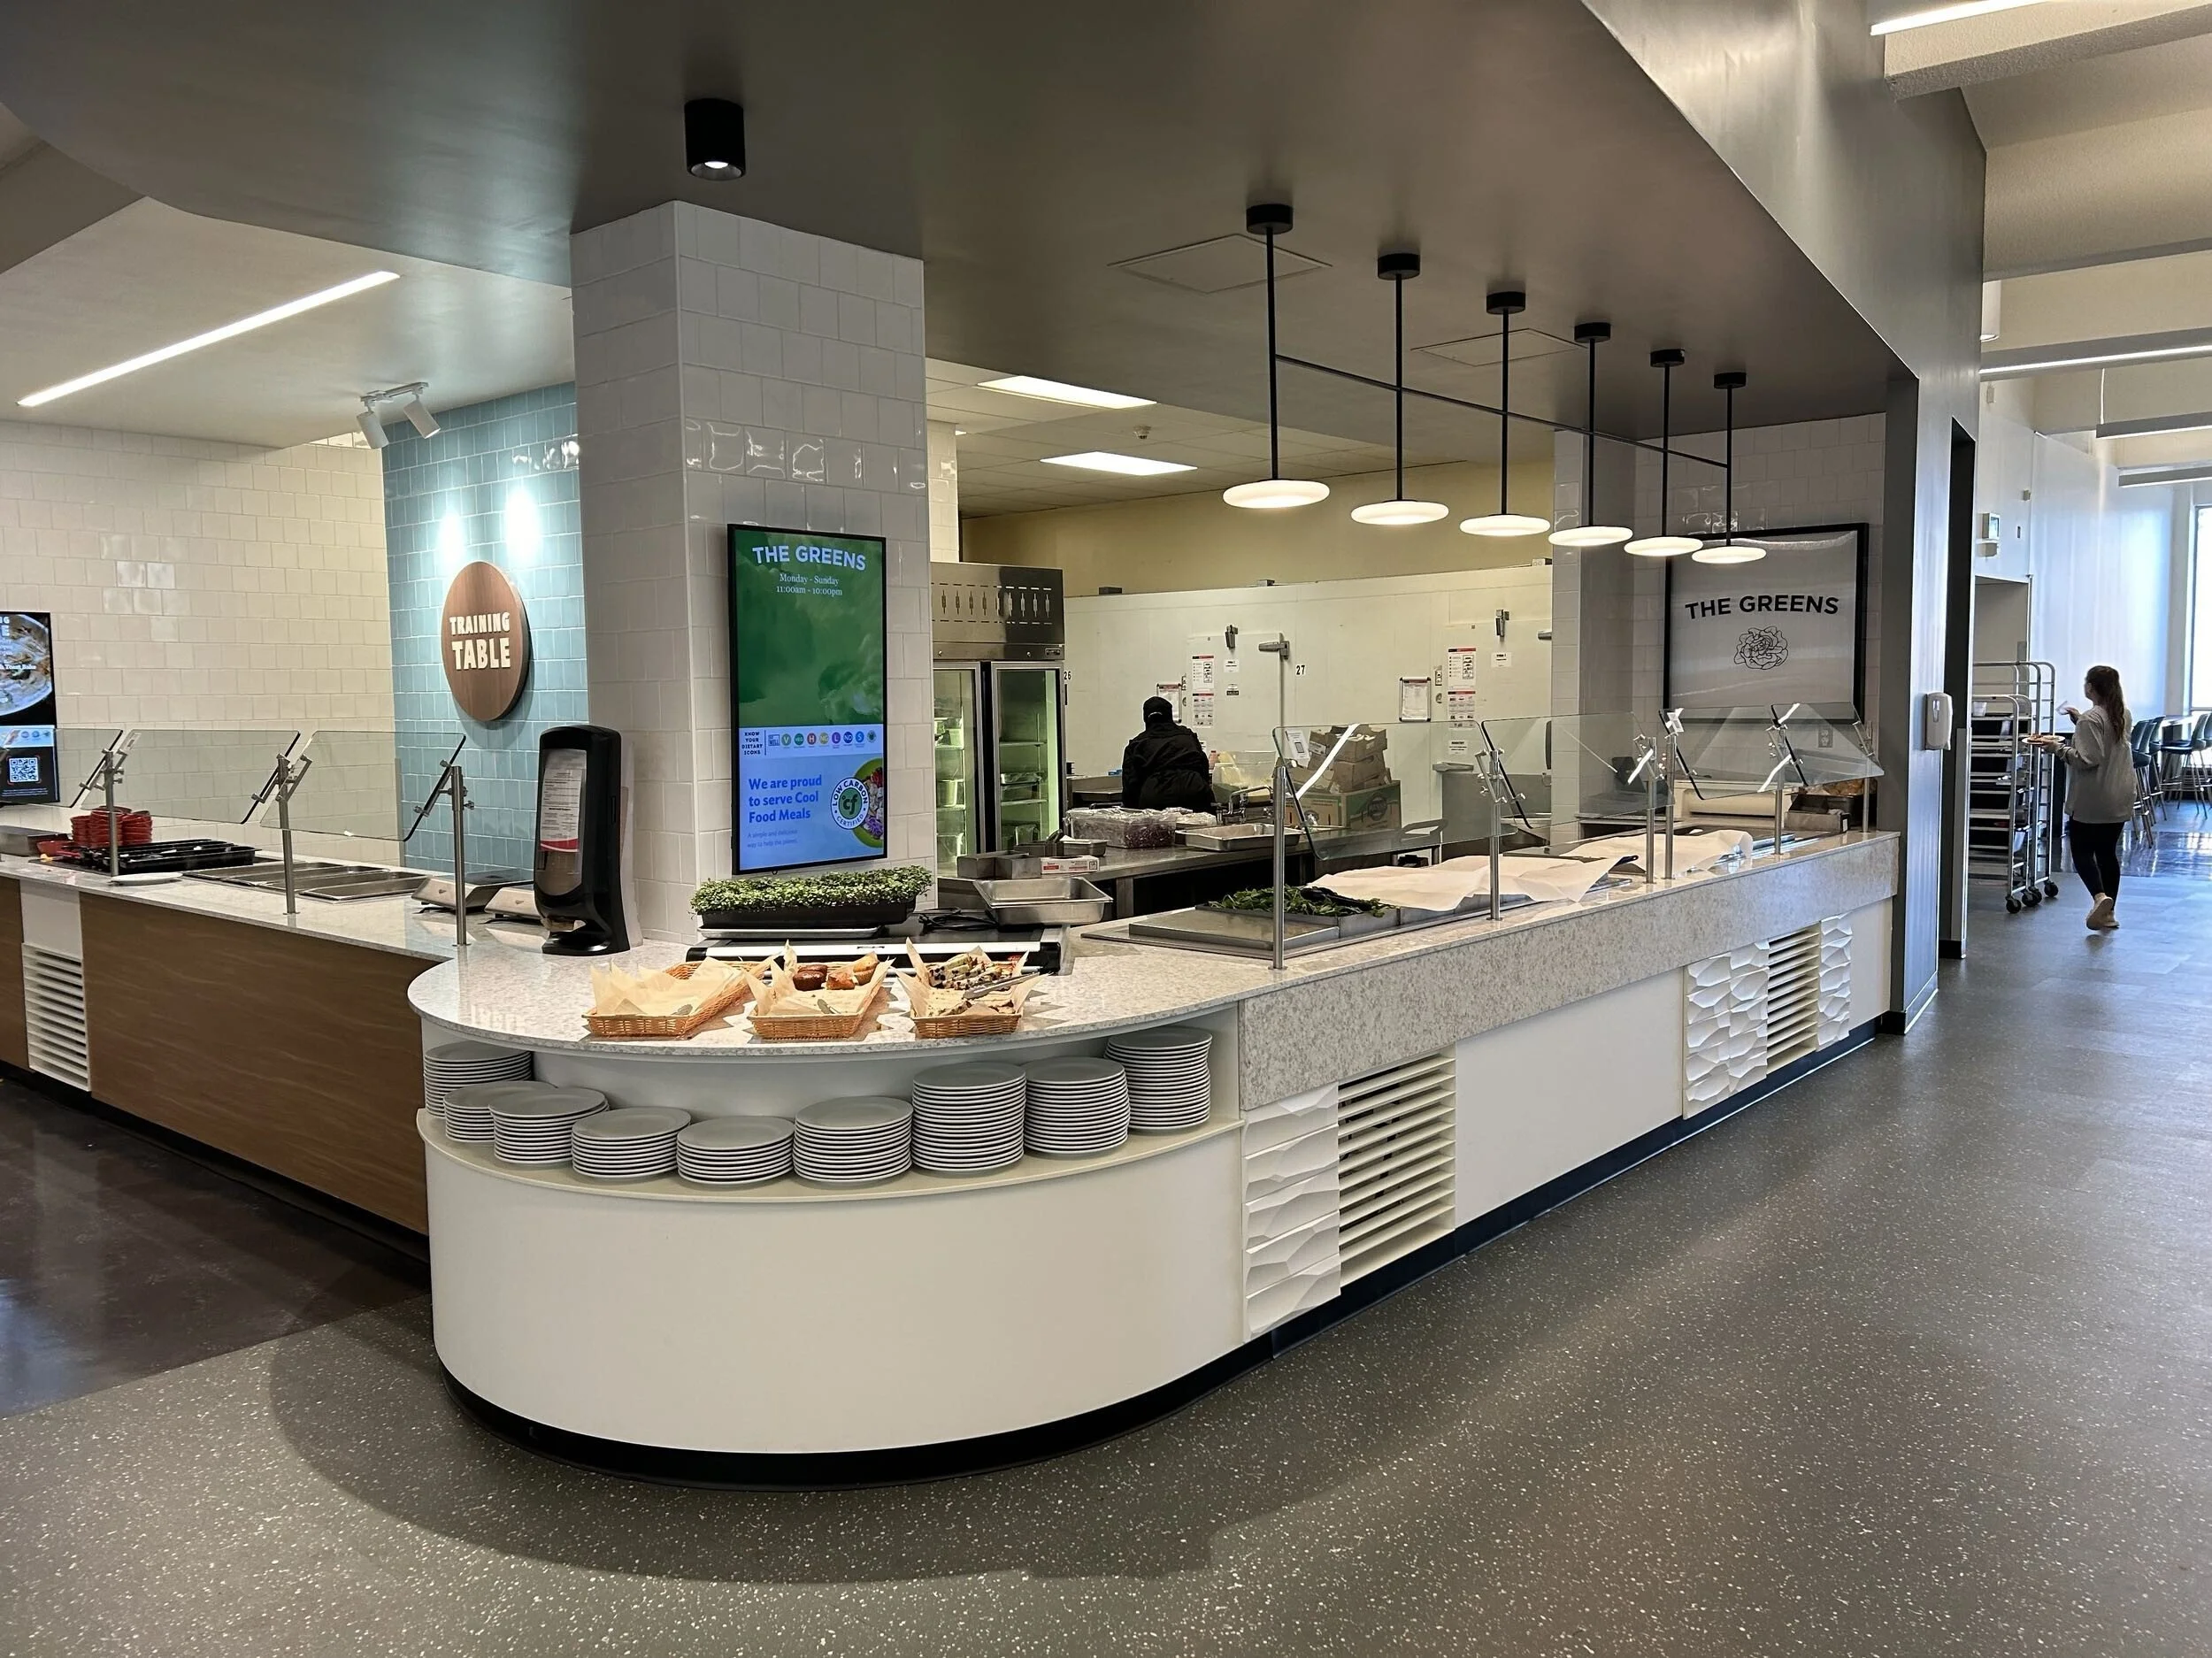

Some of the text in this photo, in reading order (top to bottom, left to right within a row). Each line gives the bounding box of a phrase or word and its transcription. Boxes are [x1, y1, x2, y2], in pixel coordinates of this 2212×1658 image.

[752, 545, 866, 571] THE GREENS
[780, 573, 808, 585] Monday
[814, 575, 840, 587] Sunday
[776, 586, 806, 595] 11:00am
[812, 587, 843, 597] 10:00pm
[1685, 595, 1839, 619] THE GREENS
[449, 612, 511, 636] TRAINING
[451, 638, 511, 671] TABLE
[1064, 671, 1071, 680] 26
[1296, 664, 1305, 675] 27
[748, 774, 821, 790] We are proud
[749, 790, 818, 807] to serve Cool
[832, 779, 868, 806] LOW CARBON
[749, 808, 811, 823] Food Meals
[836, 814, 864, 826] CERTIFIED
